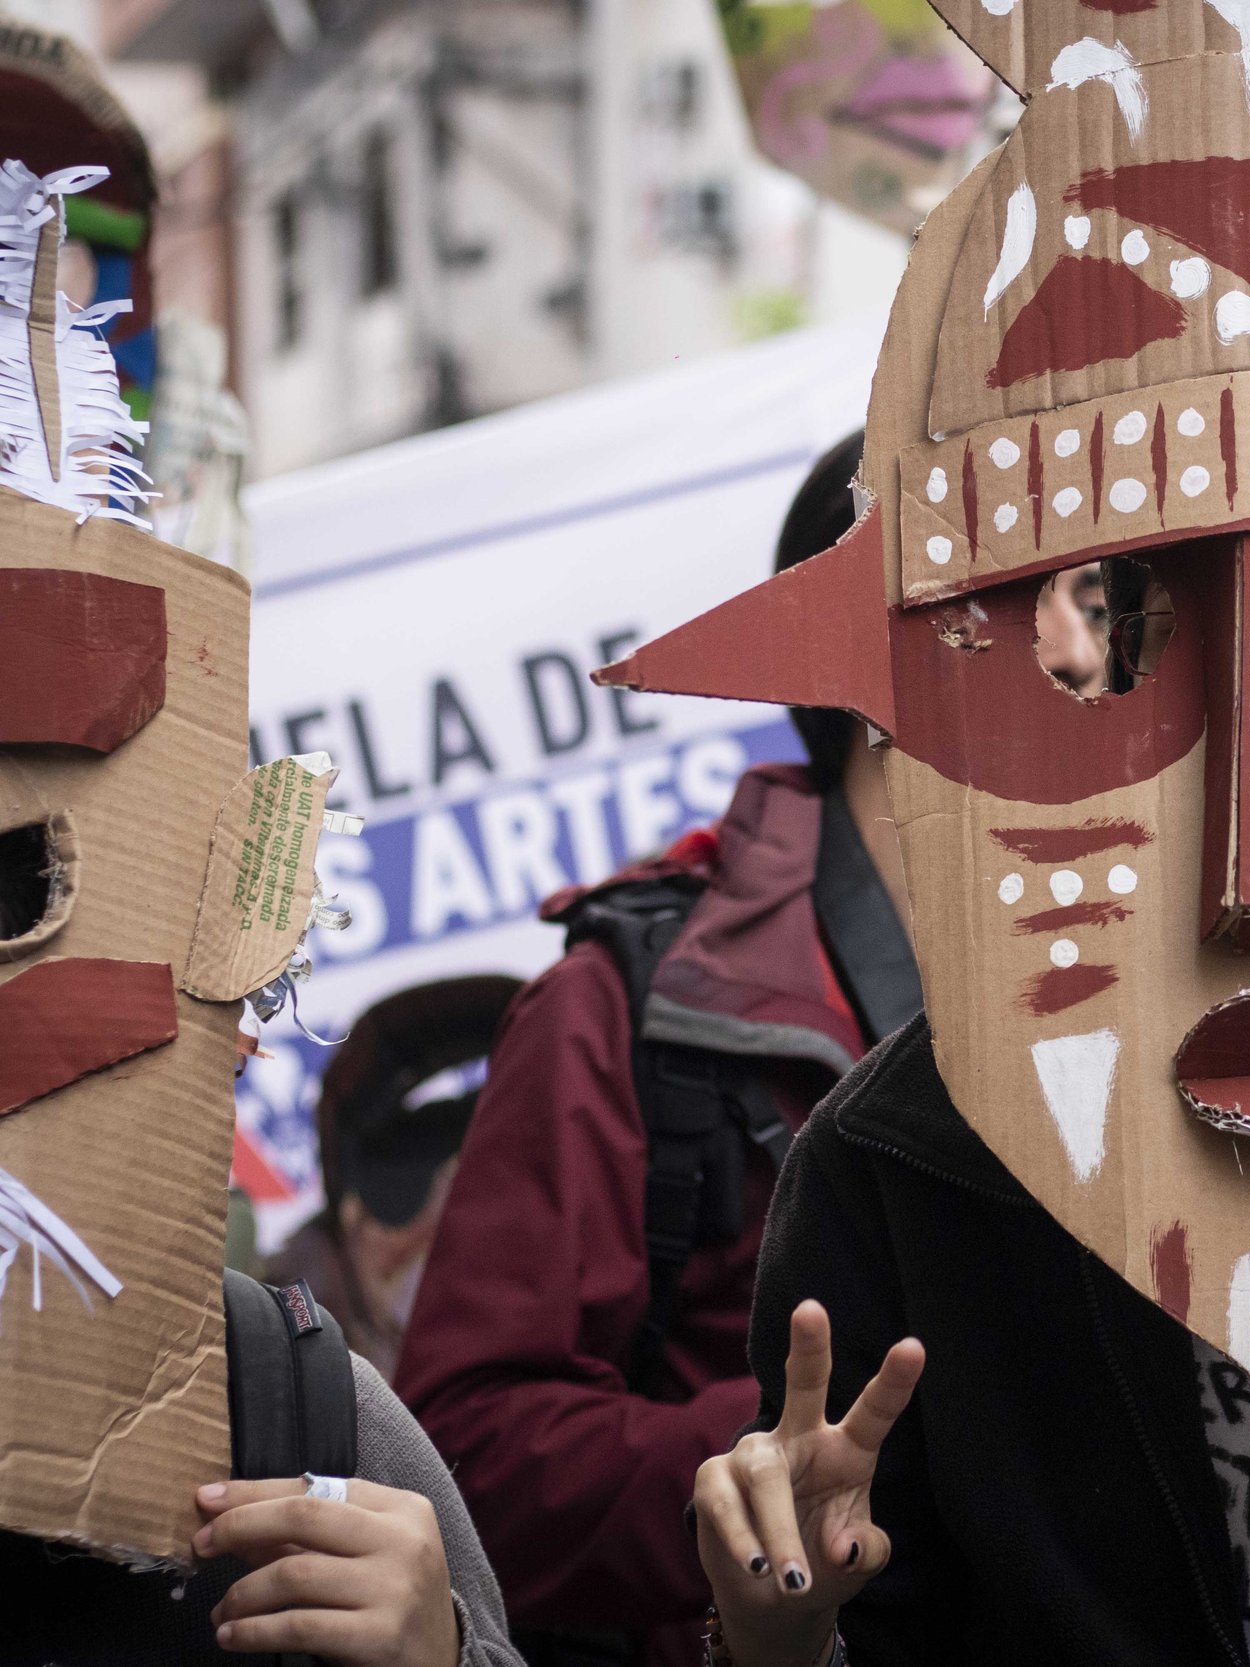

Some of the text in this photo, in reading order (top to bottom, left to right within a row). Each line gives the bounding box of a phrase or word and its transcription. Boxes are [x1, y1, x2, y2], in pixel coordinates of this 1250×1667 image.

[523, 626, 662, 758] DE
[263, 791, 276, 818] con
[297, 791, 314, 821] UAT
[411, 737, 748, 937] ARTES
[241, 838, 254, 866] SIN
[259, 836, 287, 922] descremada
[275, 820, 309, 931] homogeneizada
